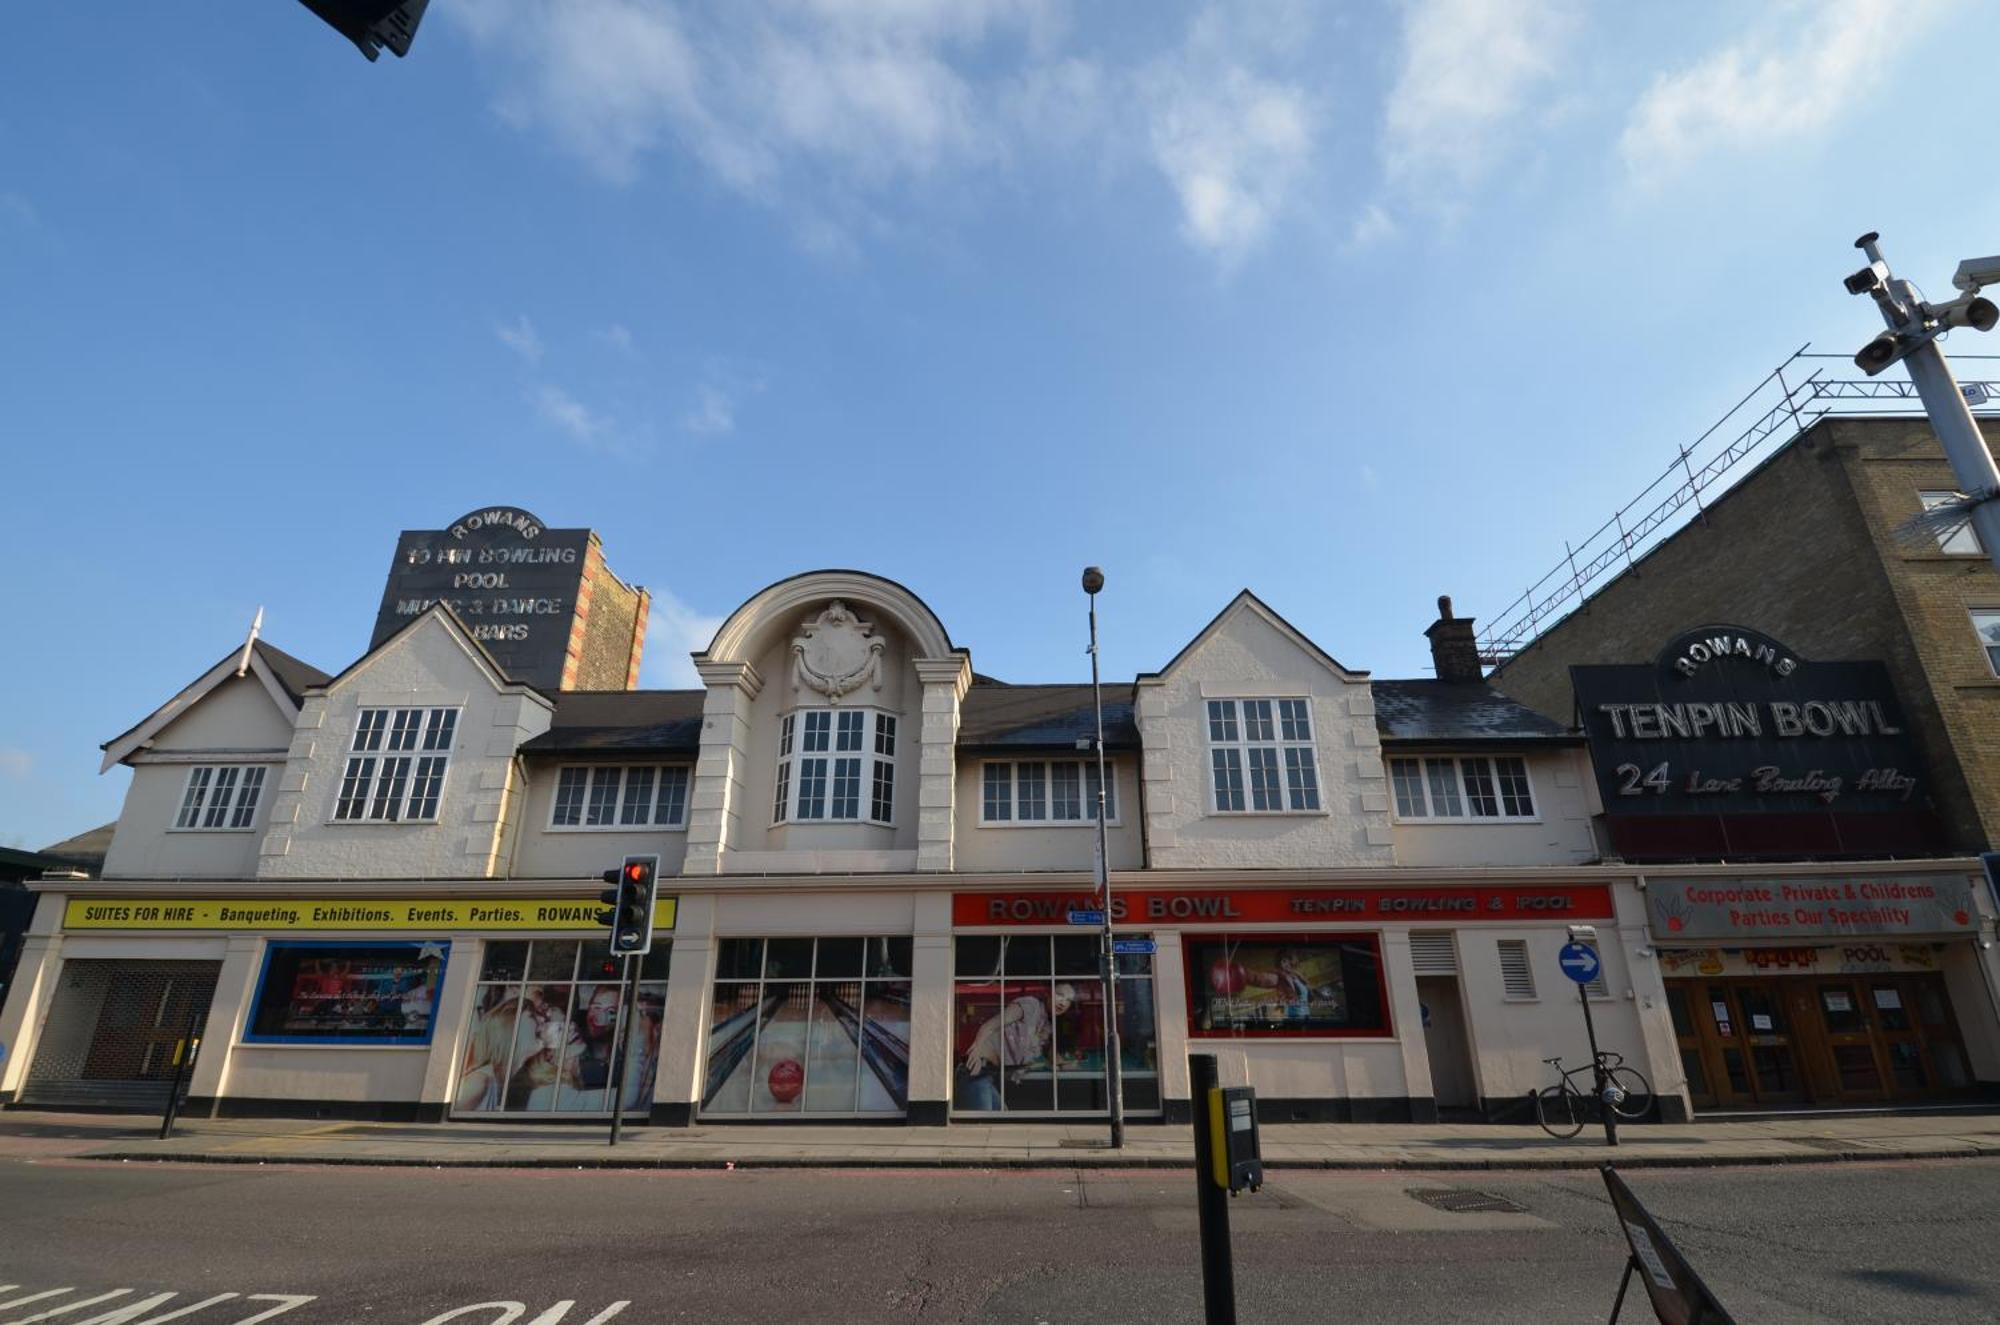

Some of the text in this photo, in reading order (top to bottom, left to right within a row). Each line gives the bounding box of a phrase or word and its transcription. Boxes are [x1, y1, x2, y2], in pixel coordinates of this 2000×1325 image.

[450, 510, 540, 541] ROWANS
[478, 548, 577, 564] BOWLING
[454, 573, 510, 589] POOL
[492, 598, 562, 615] DANCE
[474, 623, 529, 641] BARS
[1675, 636, 1797, 677] ROWANS
[1600, 701, 1899, 738] TENPIN BOWL
[1615, 762, 1672, 795] 24
[1687, 771, 1742, 792] Lane
[1751, 766, 1844, 802] Bowling
[1685, 885, 1772, 906] Corporate
[1783, 884, 1838, 902] Private
[1841, 882, 1856, 900] &
[1861, 882, 1935, 900] Childrens
[1148, 896, 1241, 918] BOWL
[1291, 896, 1576, 913] TENPIN BOWLING & POOL
[85, 907, 129, 921] SUITES
[134, 907, 158, 921] FOR
[164, 907, 195, 921] HIRE
[220, 907, 300, 924] Banqueting.
[313, 907, 394, 922] Exhibitions.
[407, 907, 458, 922] Events.
[470, 907, 524, 922] Parties.
[1729, 906, 1910, 927] Parties Our Speciality
[1843, 947, 1890, 962] POOL
